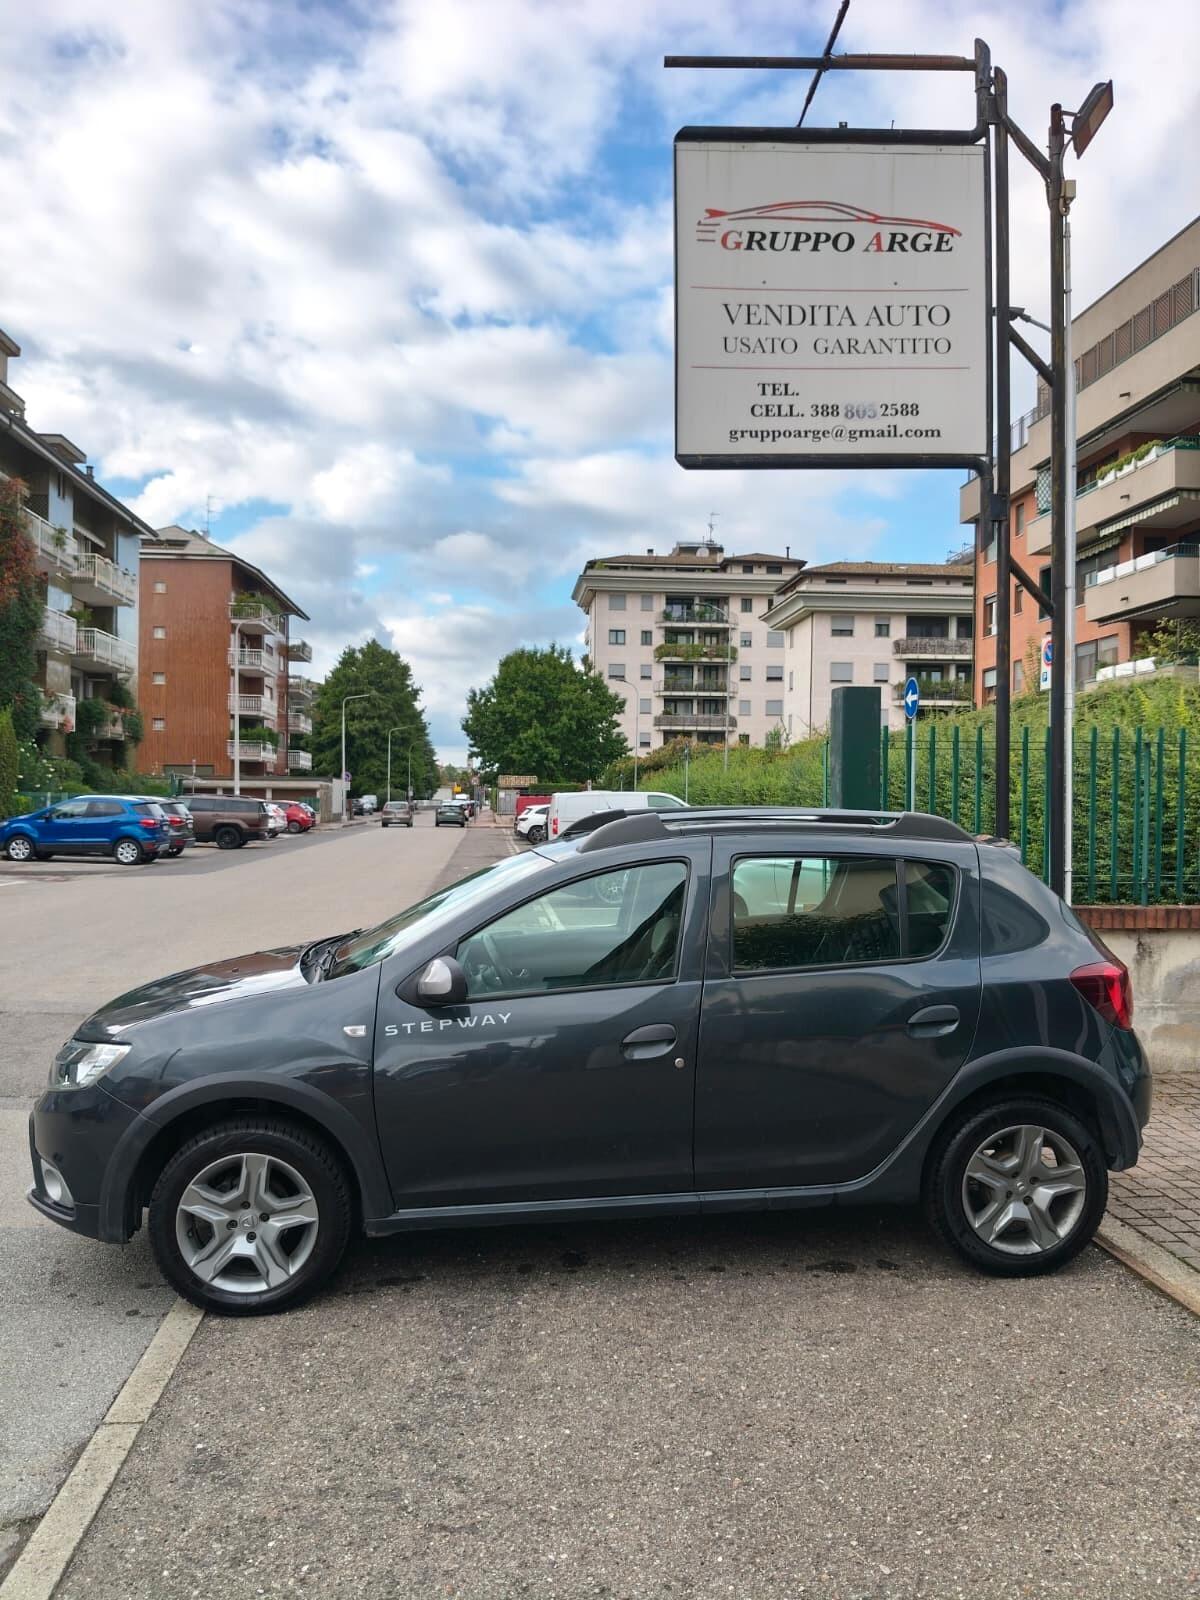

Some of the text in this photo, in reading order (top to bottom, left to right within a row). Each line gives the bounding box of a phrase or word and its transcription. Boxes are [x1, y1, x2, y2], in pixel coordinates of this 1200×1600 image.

[721, 229, 955, 253] GRUPPO ARGE
[722, 303, 951, 327] VENDITA AUTO
[723, 336, 952, 355] USATO GARANTITO
[757, 382, 800, 397] TEL.
[750, 403, 805, 418] CELL.
[810, 404, 840, 418] 388
[880, 403, 920, 417] 2588
[729, 424, 942, 443] gruppoarge@gmail.com
[384, 1012, 512, 1037] STEPWAY
